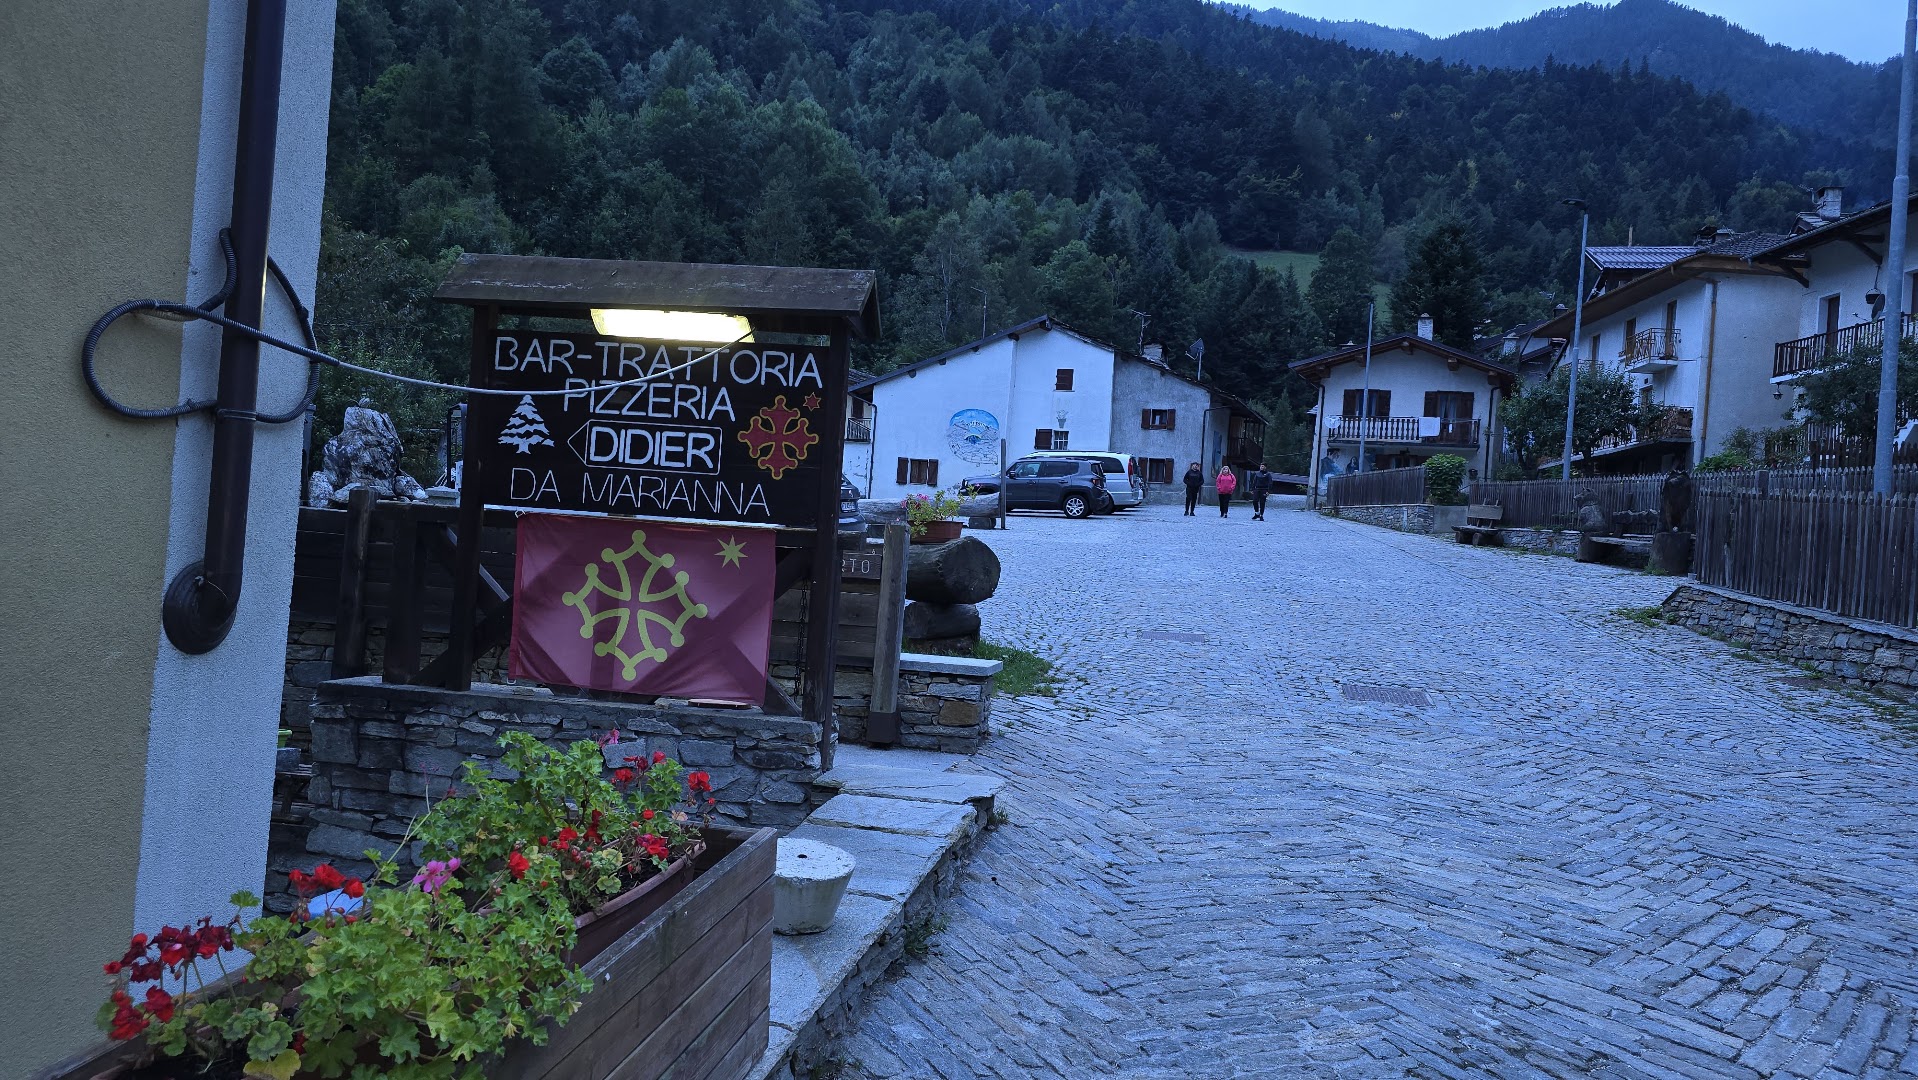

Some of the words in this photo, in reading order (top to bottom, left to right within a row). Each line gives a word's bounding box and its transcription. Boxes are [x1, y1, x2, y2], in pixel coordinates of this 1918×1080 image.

[494, 336, 822, 389] BAR-TRATTORIA
[563, 378, 736, 422] PIZZERIA
[589, 426, 714, 469] DIDIER
[510, 467, 560, 503] DA
[582, 472, 770, 517] MARIANNA
